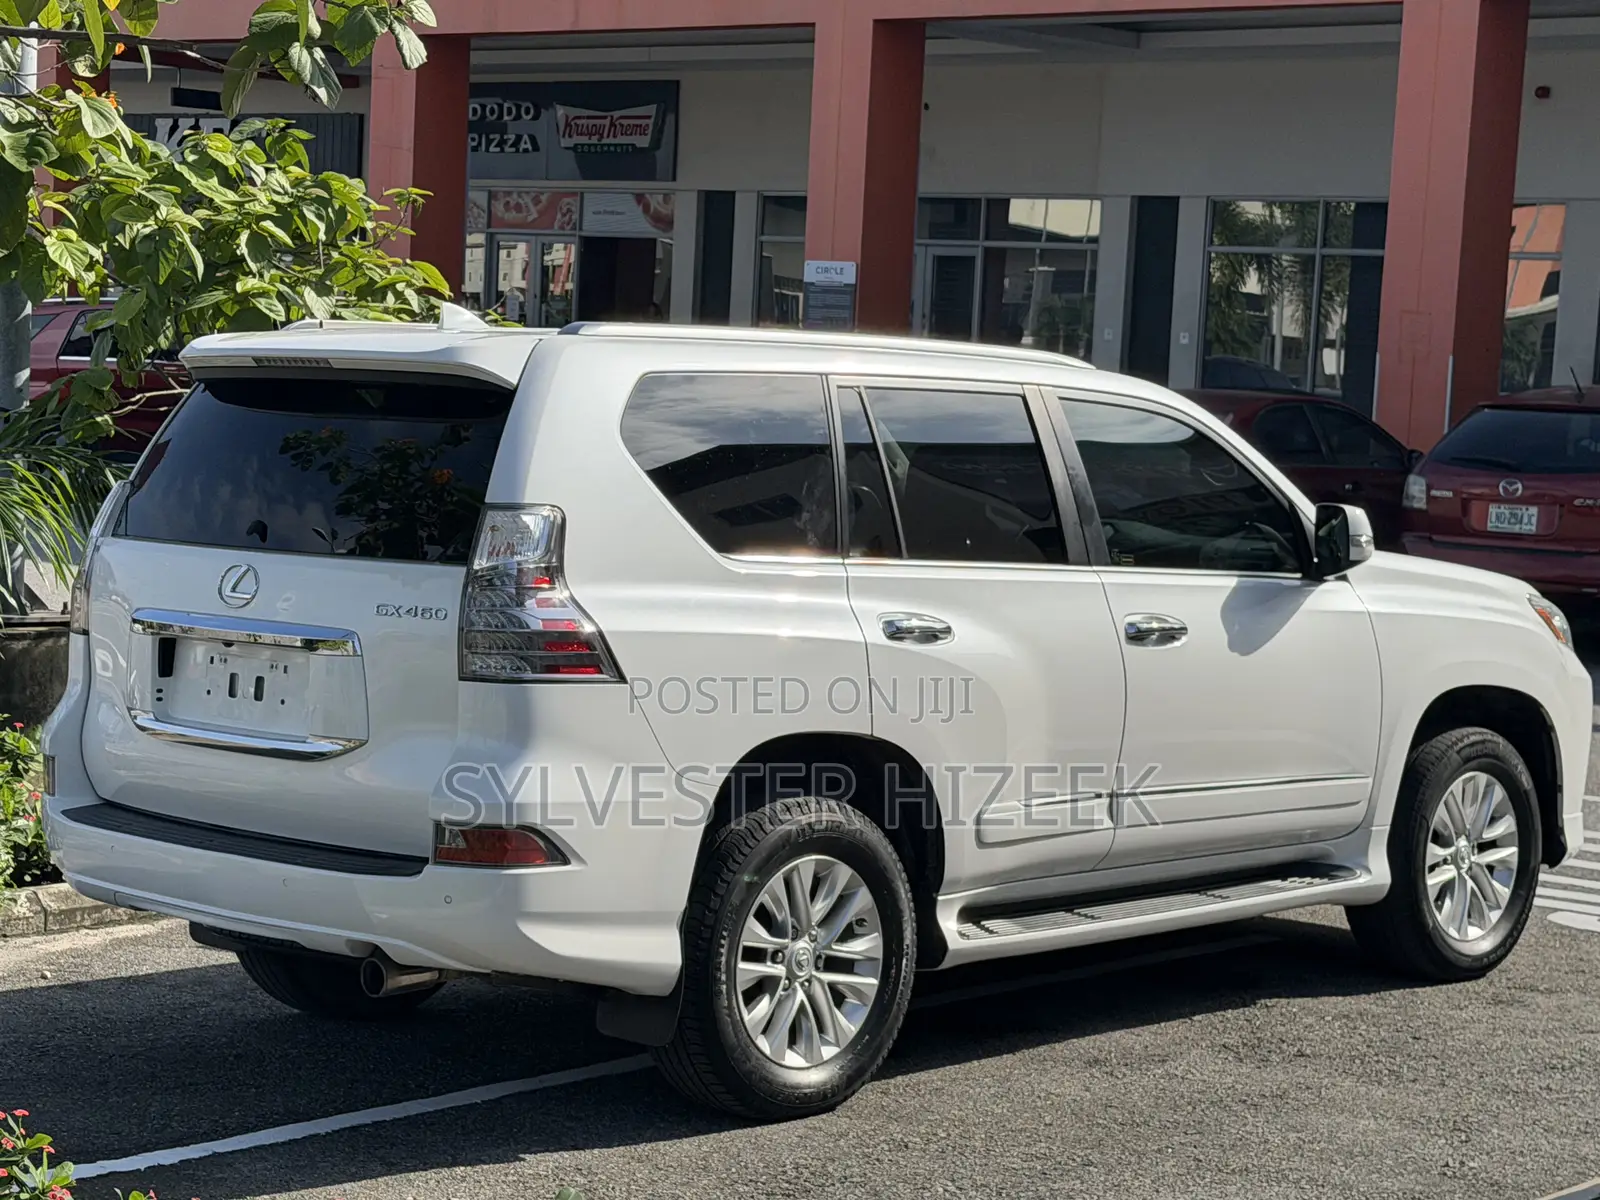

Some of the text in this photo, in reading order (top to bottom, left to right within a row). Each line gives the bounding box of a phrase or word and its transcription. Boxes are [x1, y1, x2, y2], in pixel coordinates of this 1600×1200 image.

[469, 102, 535, 120] DODO
[562, 114, 652, 142] Krispy Kreme
[468, 133, 533, 152] PIZZA
